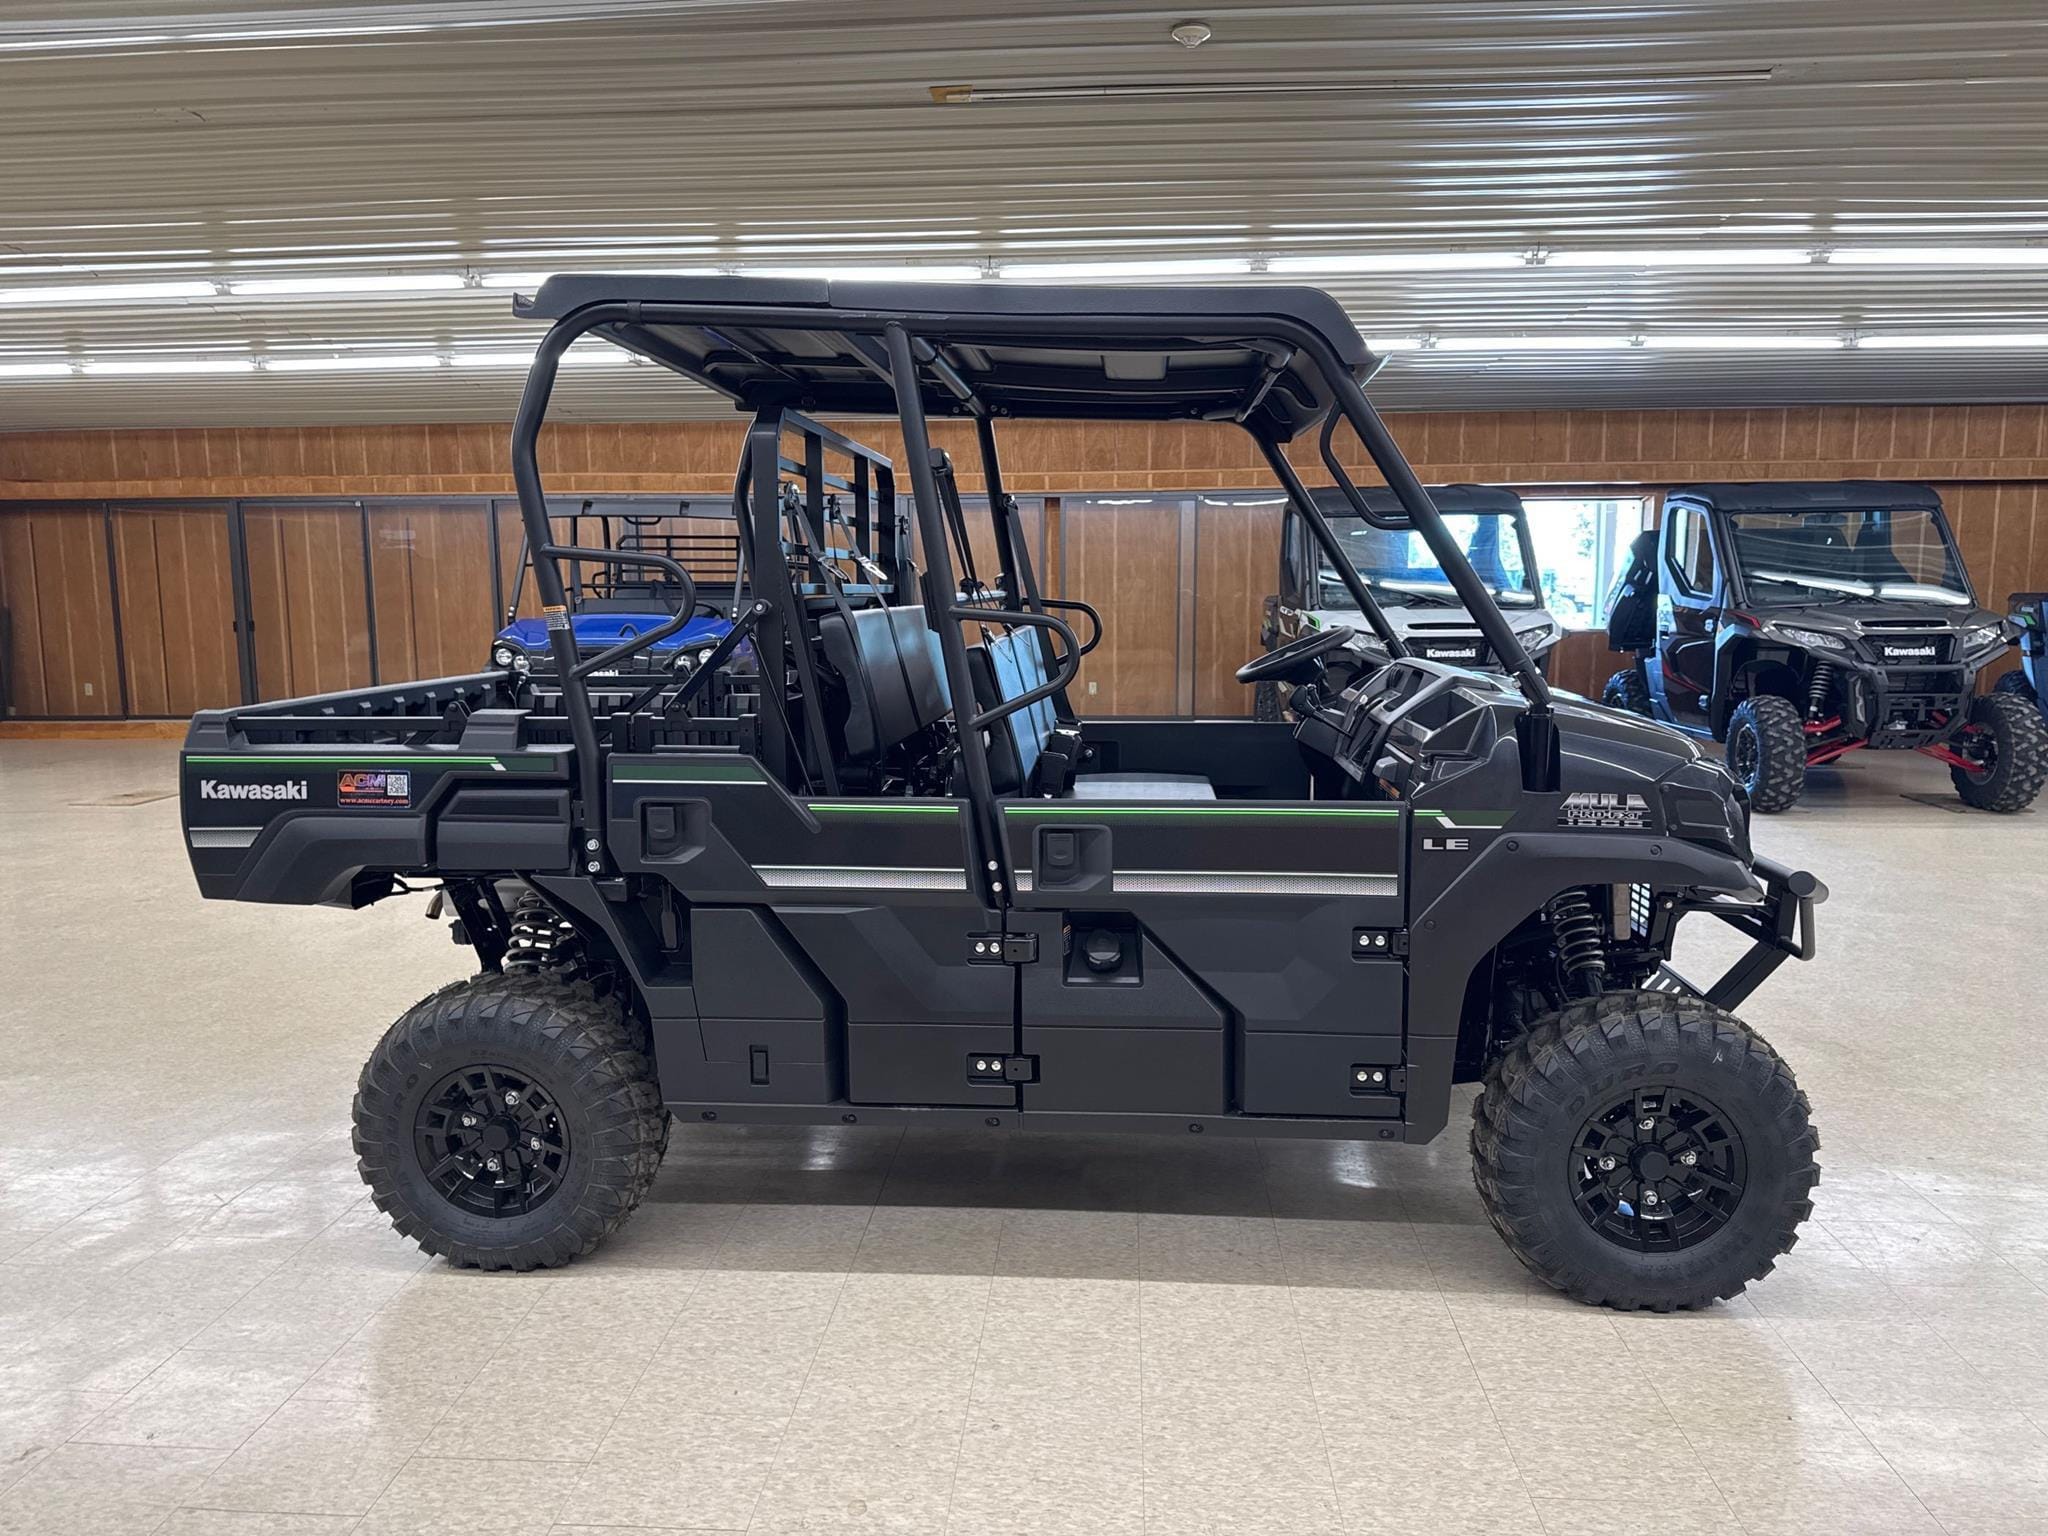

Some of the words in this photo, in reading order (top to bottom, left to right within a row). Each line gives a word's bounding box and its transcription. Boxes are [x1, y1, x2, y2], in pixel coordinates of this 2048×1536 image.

[1426, 648, 1476, 658] Kawasaki
[1884, 646, 1936, 656] Kawasaki
[340, 773, 386, 787] ACM
[200, 779, 308, 800] Kawasaki
[1560, 792, 1651, 812] MULE
[1423, 838, 1469, 850] LE
[1567, 1061, 1679, 1118] DURO
